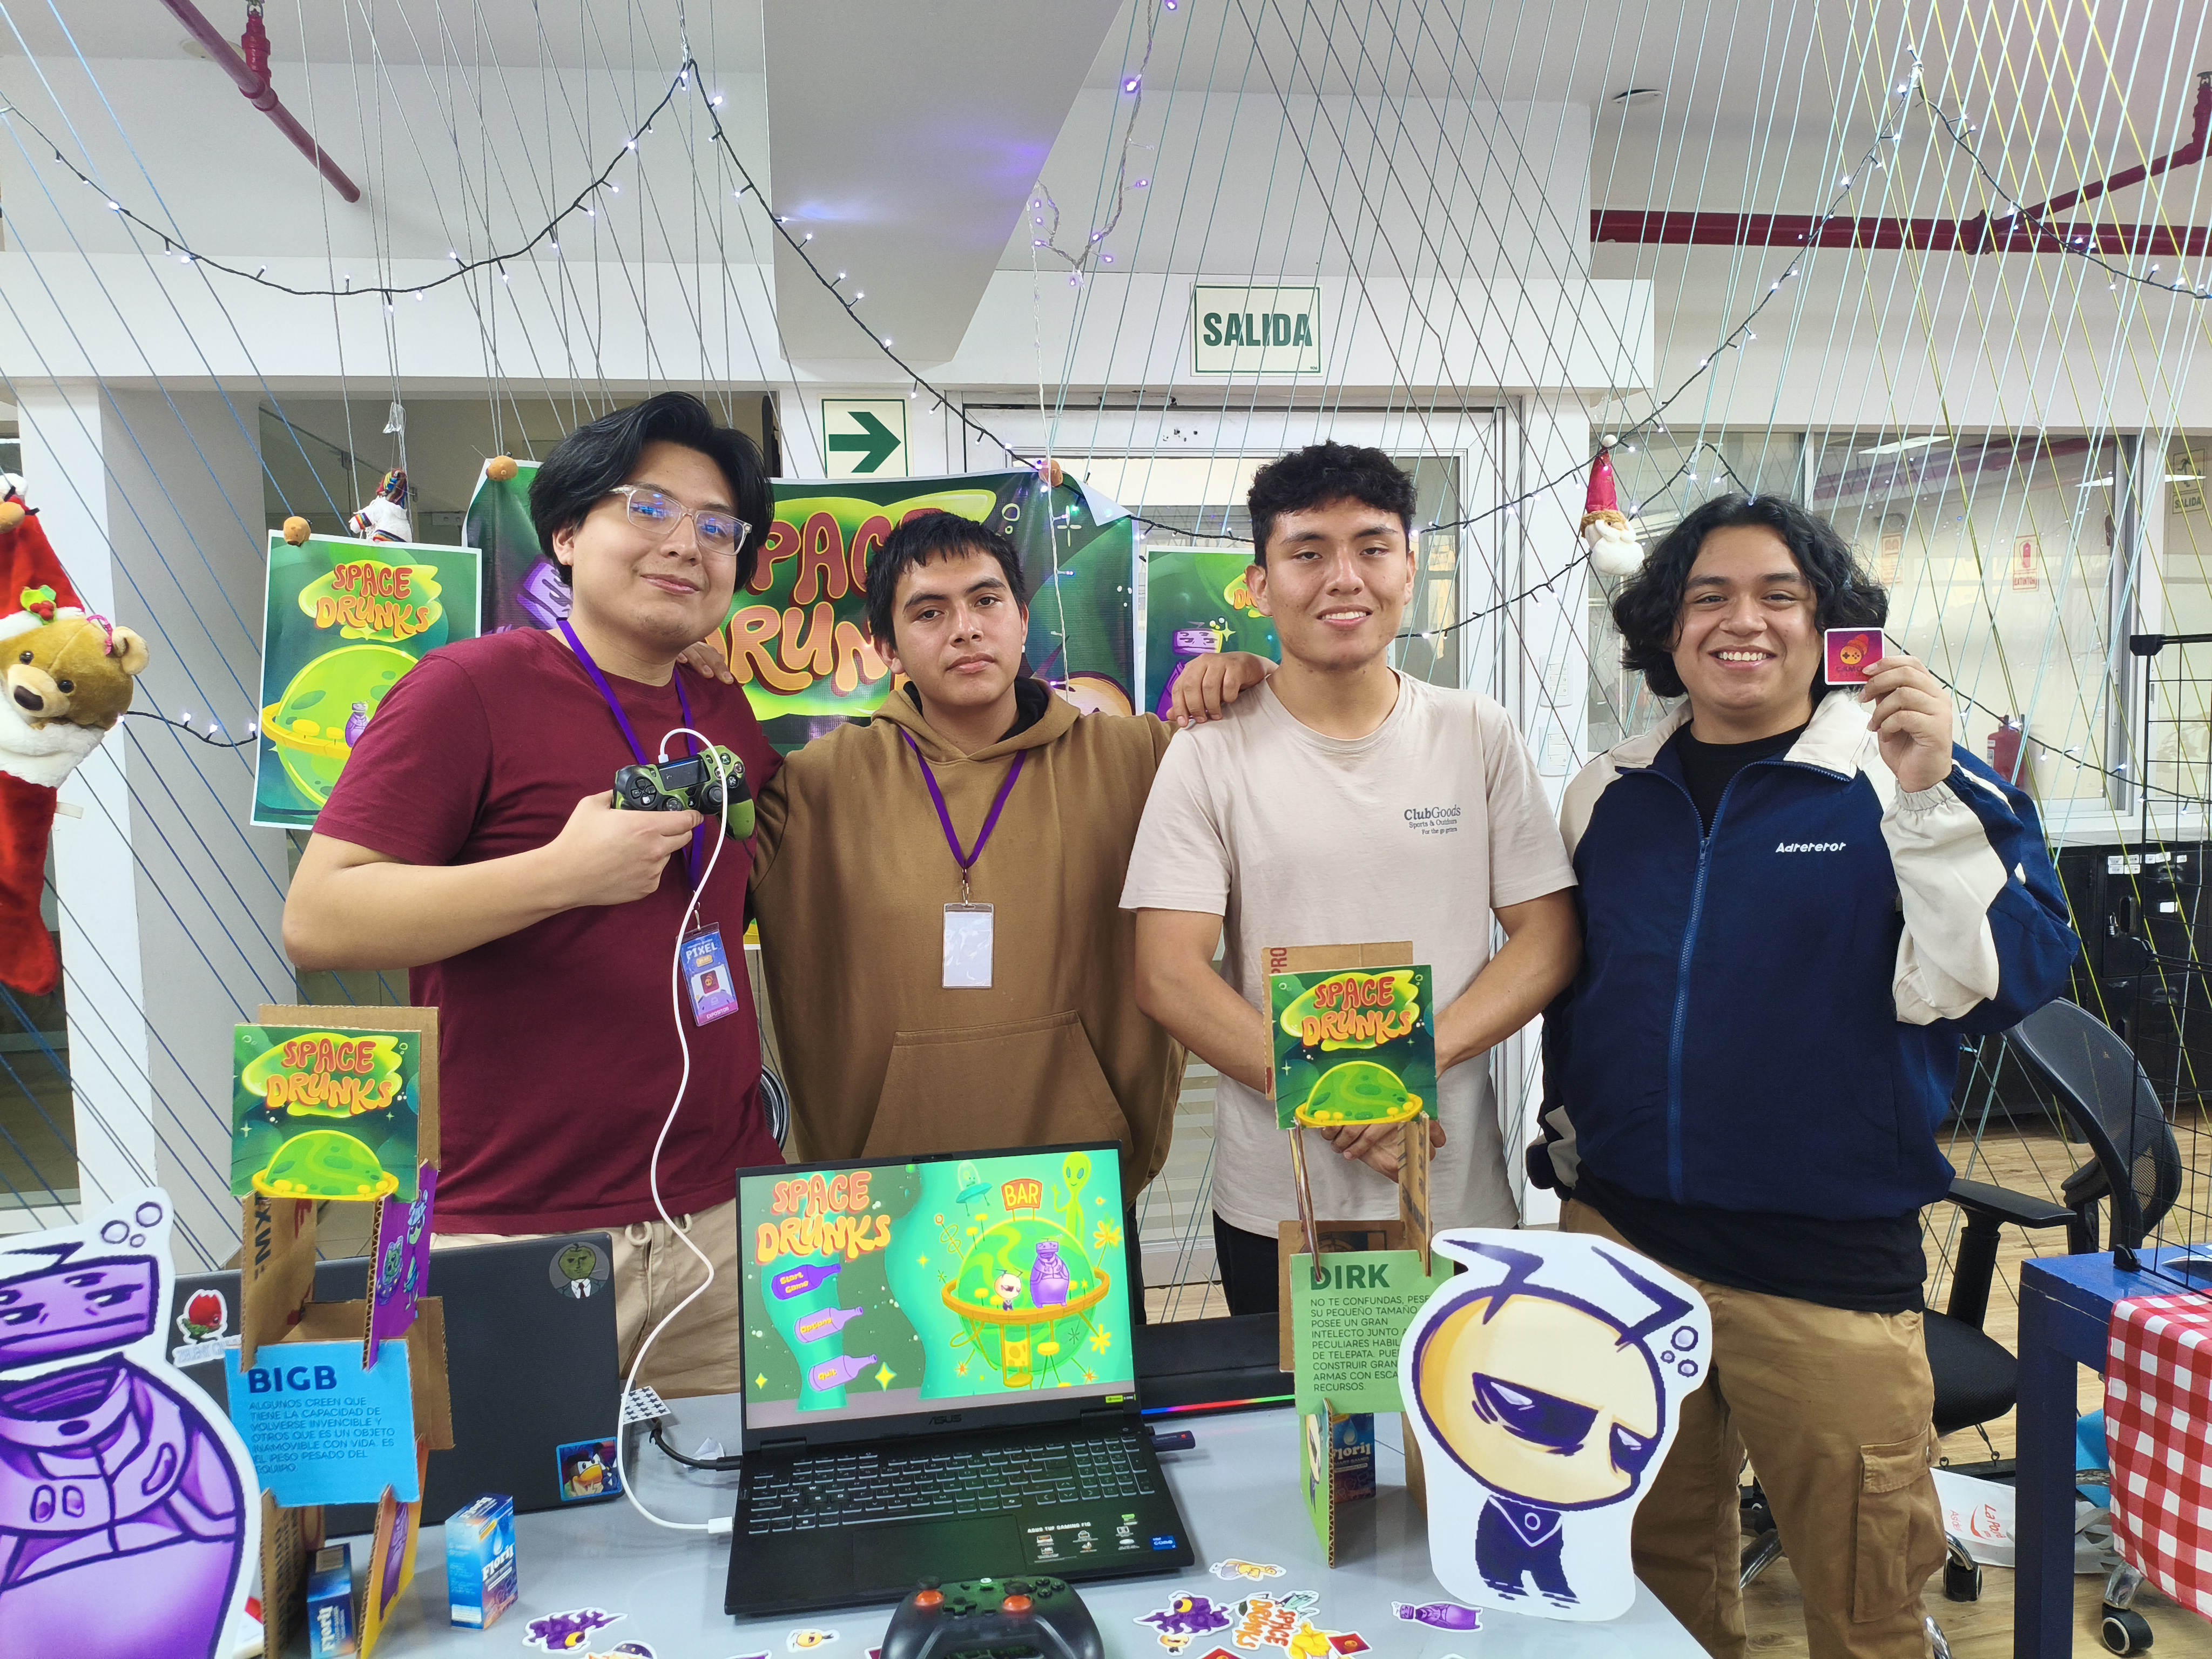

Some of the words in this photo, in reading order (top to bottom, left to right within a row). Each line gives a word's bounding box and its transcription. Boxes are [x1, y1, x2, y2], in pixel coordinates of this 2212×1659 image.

[1203, 312, 1313, 347] SALIDA
[2175, 496, 2201, 508] SALIDA
[746, 508, 944, 606] PAC
[332, 563, 413, 600] SPACE
[314, 595, 429, 638] DRUNKS
[704, 601, 912, 697] RUN
[1404, 804, 1461, 820] ClubGoods
[1409, 821, 1428, 829] Sports
[1775, 842, 1846, 853] Adrereror
[1313, 976, 1395, 1011] SPACE
[1301, 1009, 1412, 1047] DRUNKS
[281, 1038, 376, 1074] SPACE
[266, 1071, 393, 1116] DRUNKS
[771, 1171, 872, 1217] SPACE
[1004, 1182, 1039, 1207] BAR
[756, 1215, 891, 1265] DRUNKS
[780, 1272, 804, 1285] Start
[1310, 1264, 1390, 1290] DIRK
[785, 1280, 809, 1293] Game
[1311, 1298, 1325, 1306] NO
[1328, 1298, 1340, 1306] TE
[1343, 1296, 1404, 1306] CONFUNDAS,
[1311, 1309, 1323, 1317] SU
[1326, 1306, 1372, 1317] PEQUEÑO
[1375, 1305, 1418, 1315] TAMAÑO
[1312, 1319, 1341, 1327] POSEE
[1344, 1319, 1358, 1327] UN
[1361, 1318, 1388, 1326] GRAN
[1312, 1328, 1364, 1338] INTELECTO
[1367, 1328, 1399, 1337] JUNTO
[1312, 1339, 1370, 1348] PECULIARES
[1373, 1338, 1400, 1346] HABIL
[1313, 1351, 1325, 1359] DE
[1379, 1349, 1399, 1357] PUE
[1313, 1360, 1367, 1370] CONSTRUIR
[248, 1365, 337, 1394] BIGB
[1313, 1372, 1347, 1380] ARMAS
[1350, 1371, 1371, 1380] CON
[1374, 1371, 1398, 1379] ESCA
[1314, 1382, 1366, 1392] RECURSOS.
[248, 1399, 302, 1410] ALGUNOS
[305, 1398, 341, 1407] CREEN
[345, 1397, 367, 1406] QUE
[251, 1411, 282, 1421] TIENE
[284, 1410, 299, 1419] LA
[301, 1407, 364, 1418] CAPACIDAD
[367, 1407, 381, 1416] DE
[928, 1414, 962, 1425] ASUS
[251, 1420, 307, 1432] VOLVERSE
[309, 1418, 373, 1428] INVENCIBLE
[375, 1417, 382, 1426] Y
[251, 1432, 290, 1443] OTROS
[293, 1430, 316, 1440] QUE
[318, 1429, 332, 1439] ES
[335, 1429, 350, 1438] UN
[353, 1427, 395, 1437] OBJETO
[252, 1440, 320, 1453] INAMOVIBLE
[323, 1439, 348, 1449] CON
[382, 1438, 395, 1447] ES
[1333, 1442, 1371, 1460] loril
[253, 1454, 267, 1464] EL
[270, 1452, 299, 1463] PESO
[301, 1450, 345, 1461] PESADO
[348, 1449, 369, 1459] DEL
[1264, 1609, 1296, 1647] SPACE
